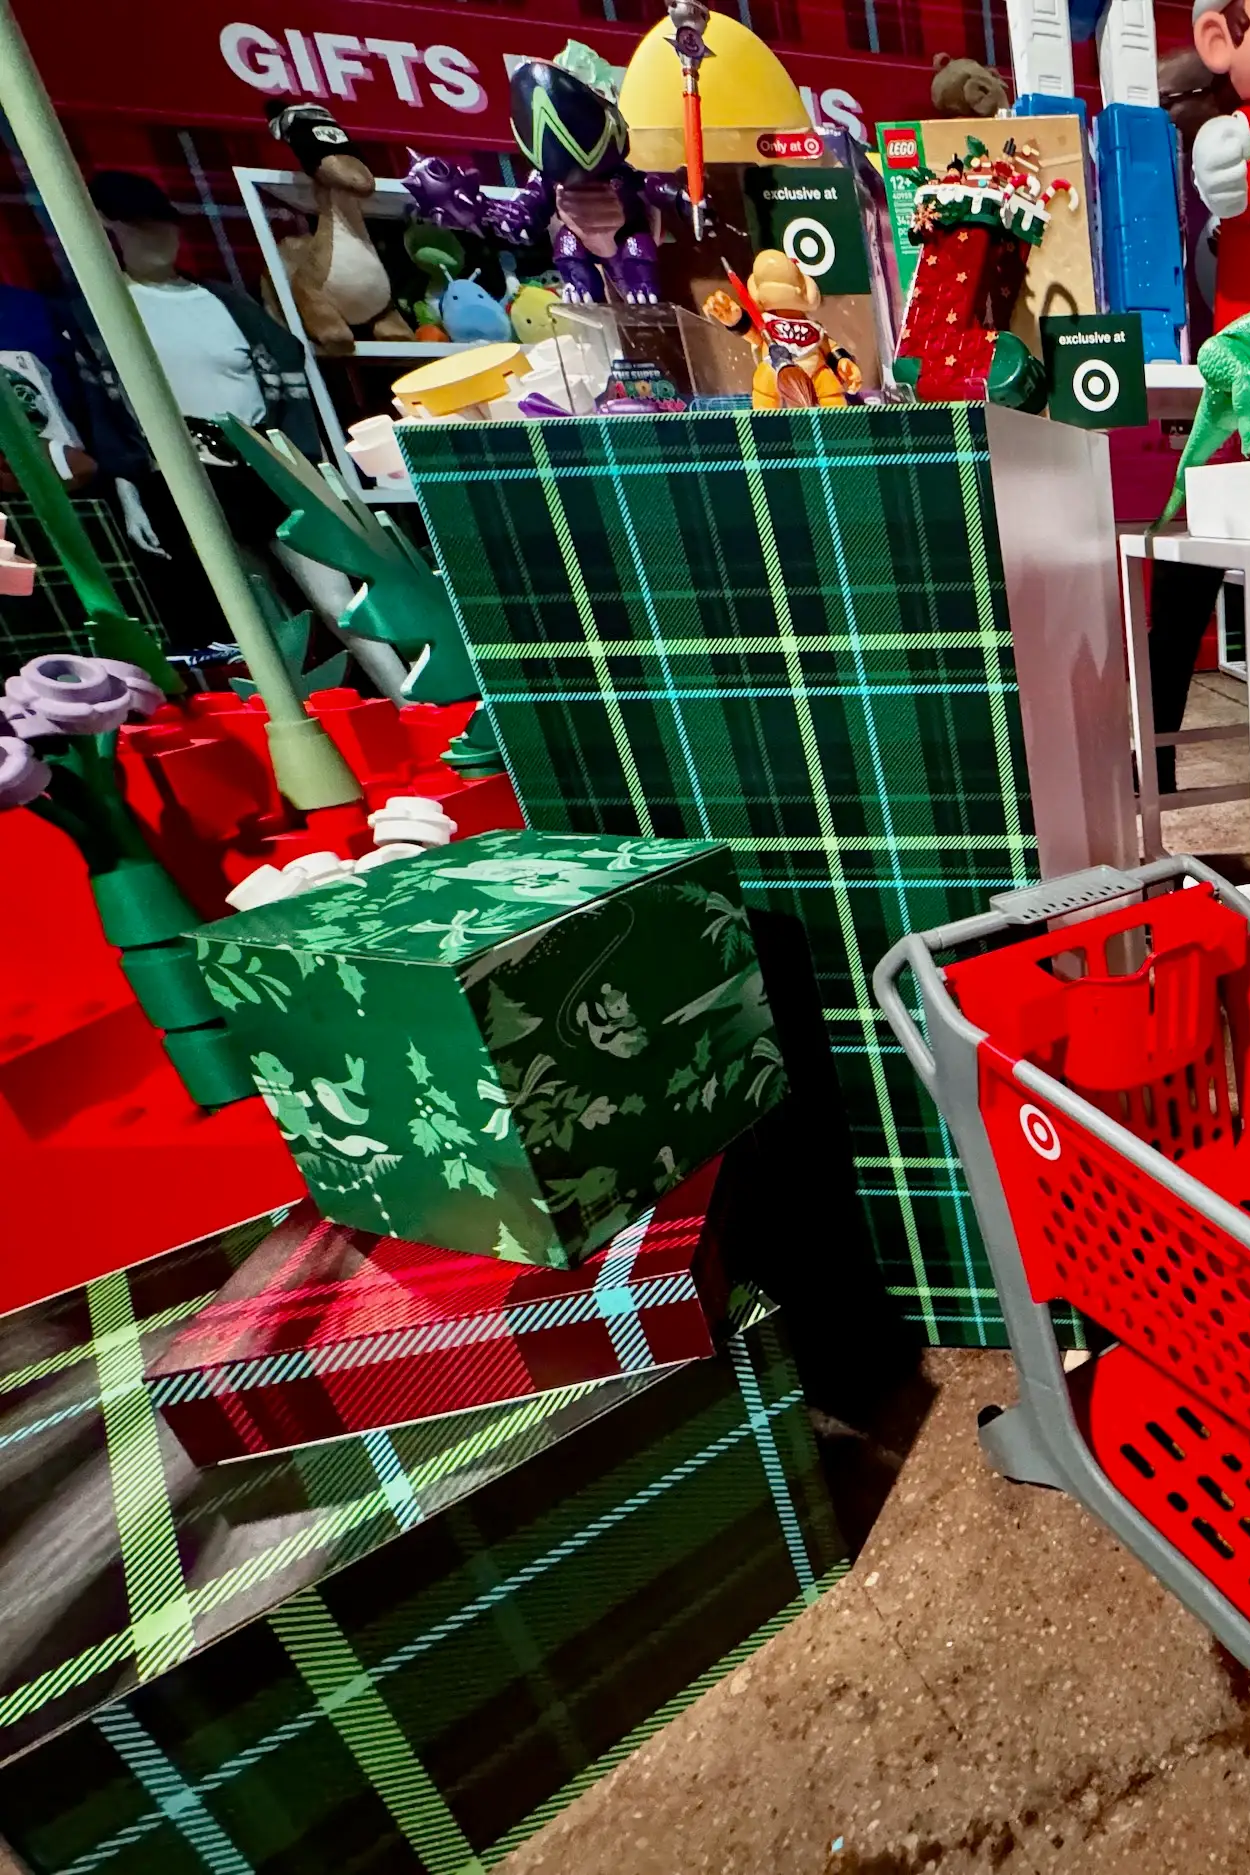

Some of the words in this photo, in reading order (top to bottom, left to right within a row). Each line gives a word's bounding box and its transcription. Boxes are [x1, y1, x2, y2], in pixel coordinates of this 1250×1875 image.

[219, 21, 487, 113] GIFTS
[760, 140, 787, 155] Only
[789, 141, 802, 152] at
[888, 141, 916, 157] LEGO
[890, 175, 911, 191] 12+
[763, 187, 821, 201] exclusive
[823, 187, 839, 201] at
[1059, 332, 1111, 346] exclusive
[1113, 331, 1126, 343] at
